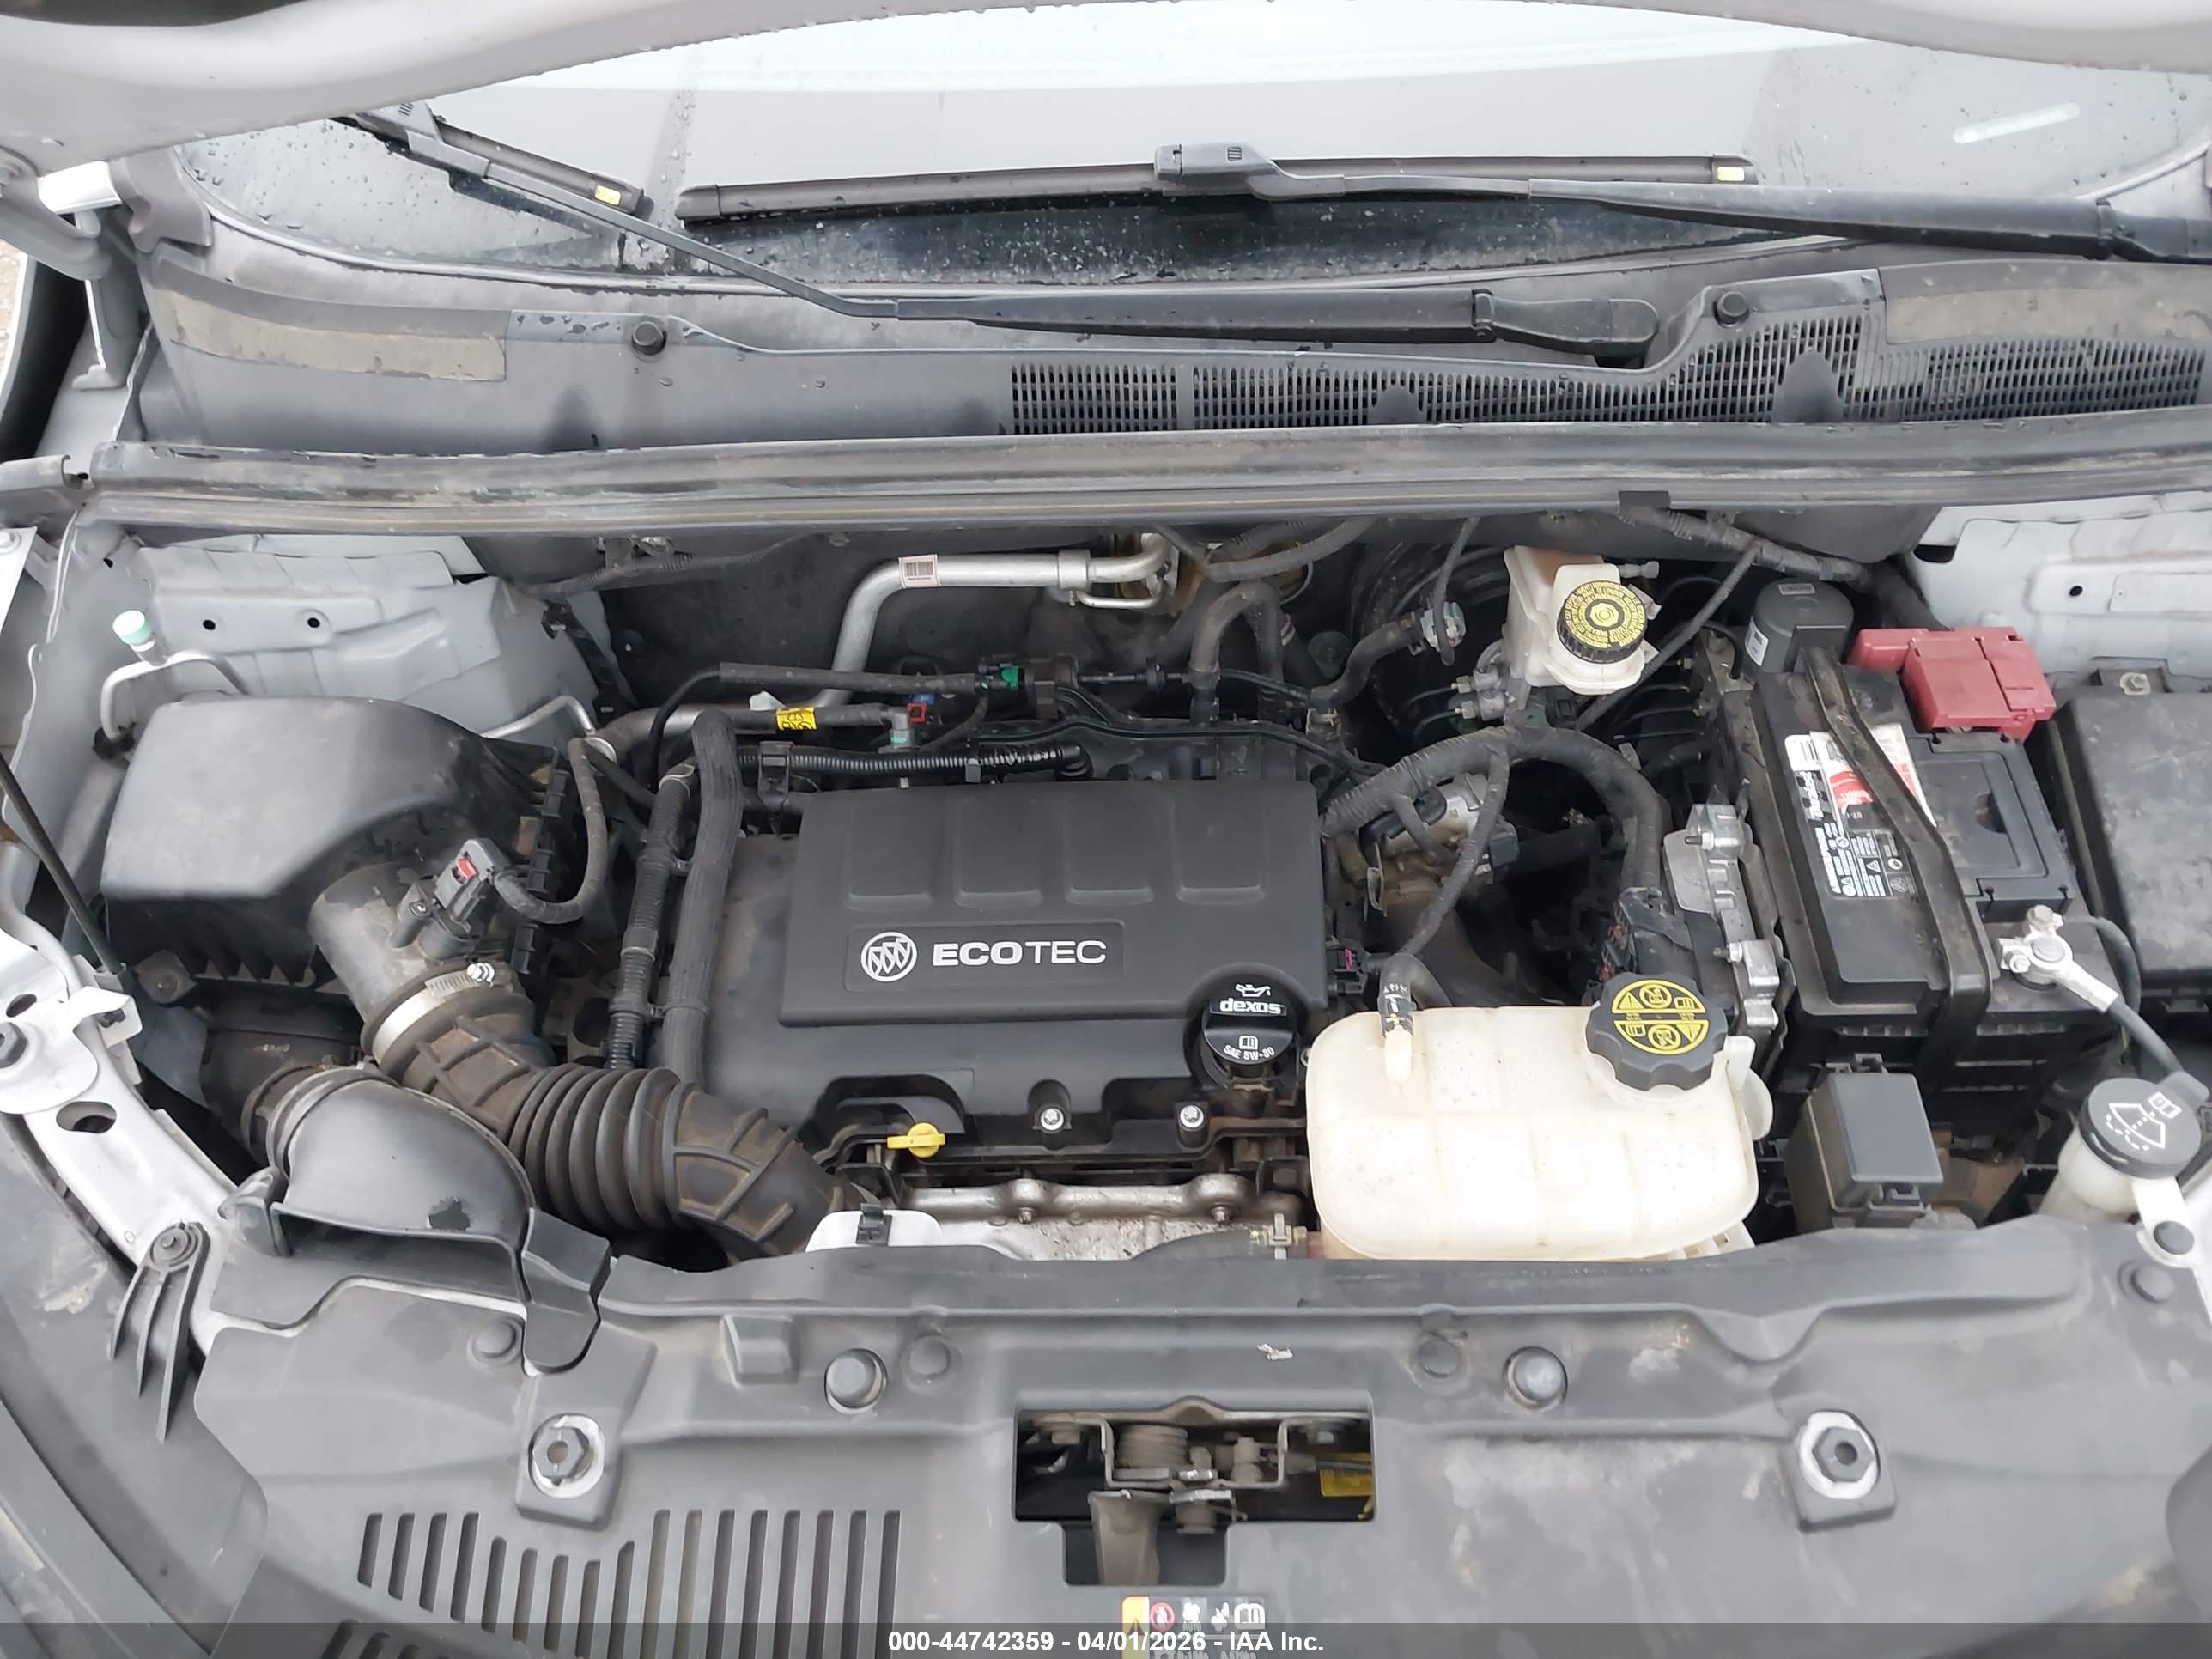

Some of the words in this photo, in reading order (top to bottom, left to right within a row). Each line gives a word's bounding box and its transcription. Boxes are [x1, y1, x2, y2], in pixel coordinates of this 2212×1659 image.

[933, 940, 1107, 966] ECOTEC
[1219, 997, 1282, 1014] dexos
[1223, 1044, 1242, 1060] SAE
[1243, 1046, 1275, 1060] 5W-30
